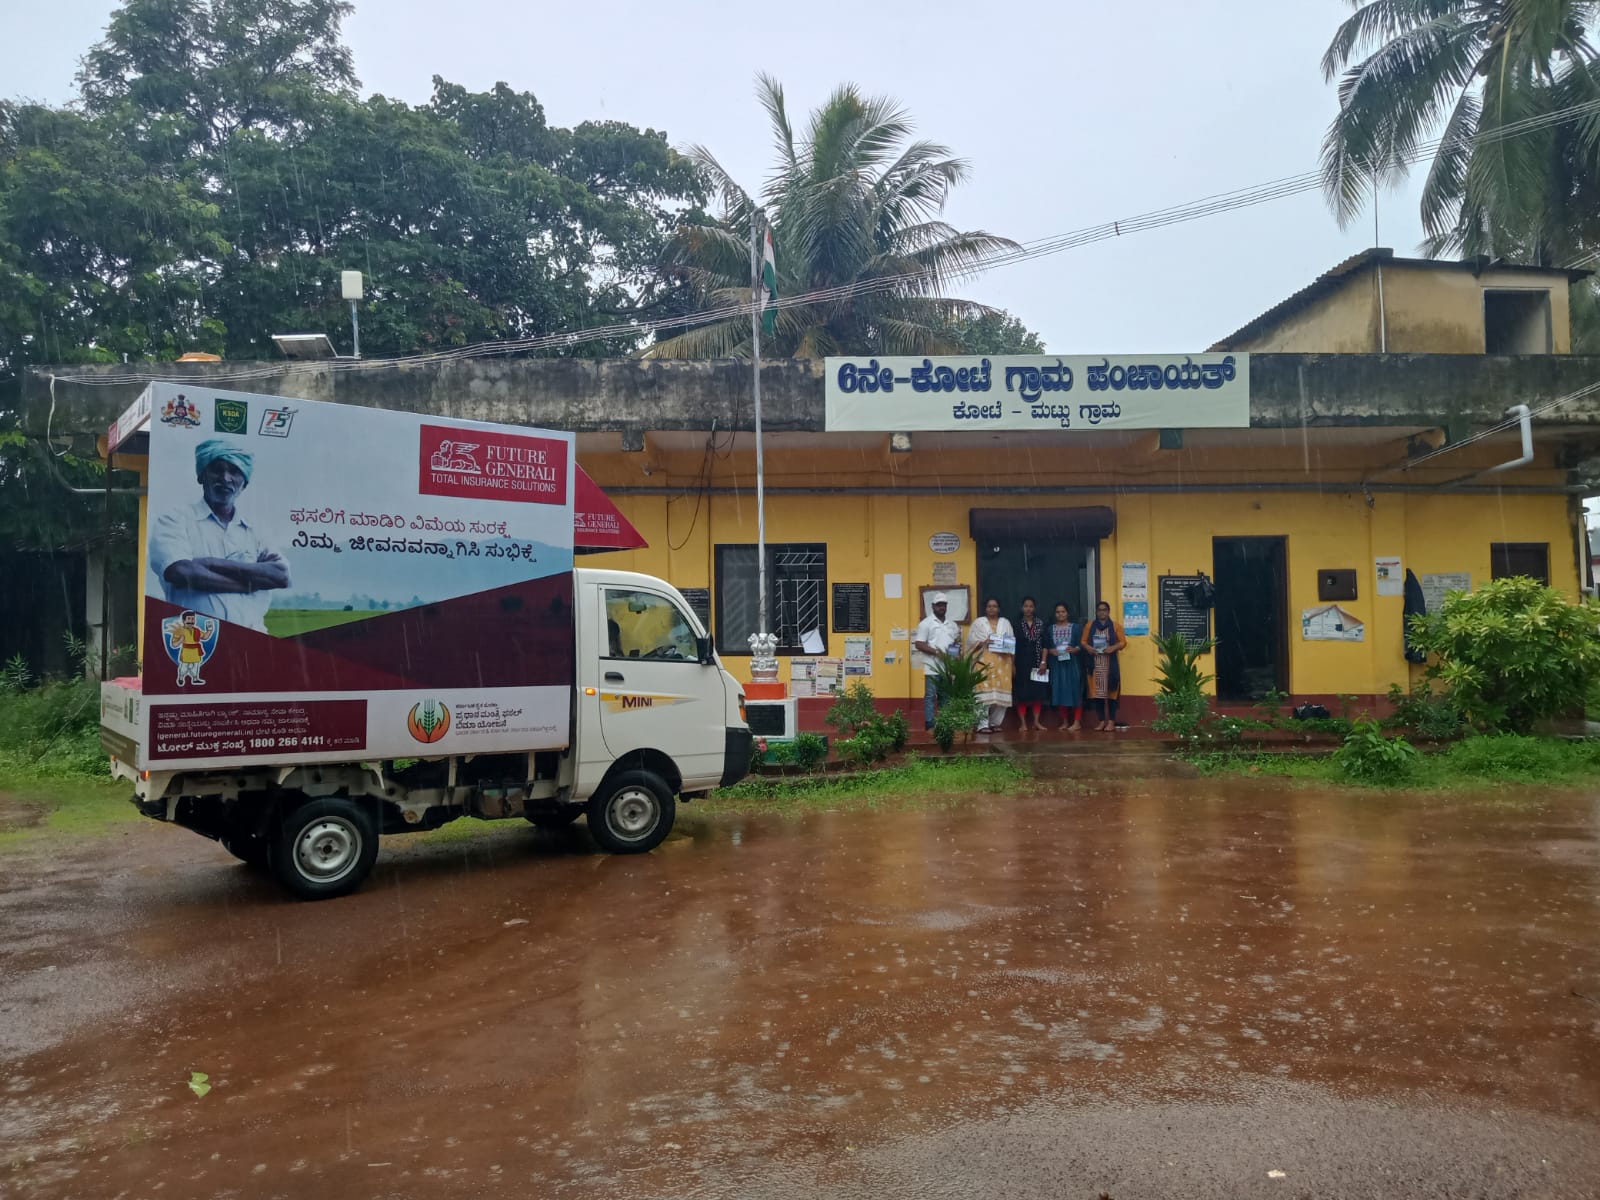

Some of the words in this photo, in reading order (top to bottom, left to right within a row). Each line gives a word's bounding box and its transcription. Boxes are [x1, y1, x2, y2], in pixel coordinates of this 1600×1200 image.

[837, 358, 992, 393] 6ನೇ-ಕೋಟೆ
[1005, 359, 1073, 402] ಗ್ರಾಮ
[1087, 355, 1236, 391] ಪಂಚಾಯತ್
[953, 401, 1002, 419] ಕೋಟೆ
[1031, 401, 1070, 427] ಮಟ್ಟು
[1080, 401, 1121, 424] ಗ್ರಾಮ
[488, 445, 547, 464] FUTURE
[486, 462, 556, 481] GENERALI
[432, 473, 459, 485] TOTAL
[461, 476, 509, 489] INSURANCE
[511, 480, 556, 493] SOLUTIONS
[290, 508, 345, 525] ಫಸಲಿಗೆ
[350, 514, 405, 528] ಮಾಡಿರಿ
[410, 516, 466, 532] ವಿಮೆಯ
[469, 520, 511, 538] ಸುರಕ್ಷೆ
[587, 513, 616, 521] FUTURE
[292, 531, 342, 553] ನಿಮ್ಮ
[349, 536, 480, 559] ಜೀವನವನ್ನಾಗಿಸಿ
[485, 543, 537, 562] ಸುಭಿಕ್ಷೆ
[622, 695, 652, 709] MINI
[249, 737, 275, 748] 1800
[278, 737, 298, 747] 266
[301, 735, 324, 746] 4141
